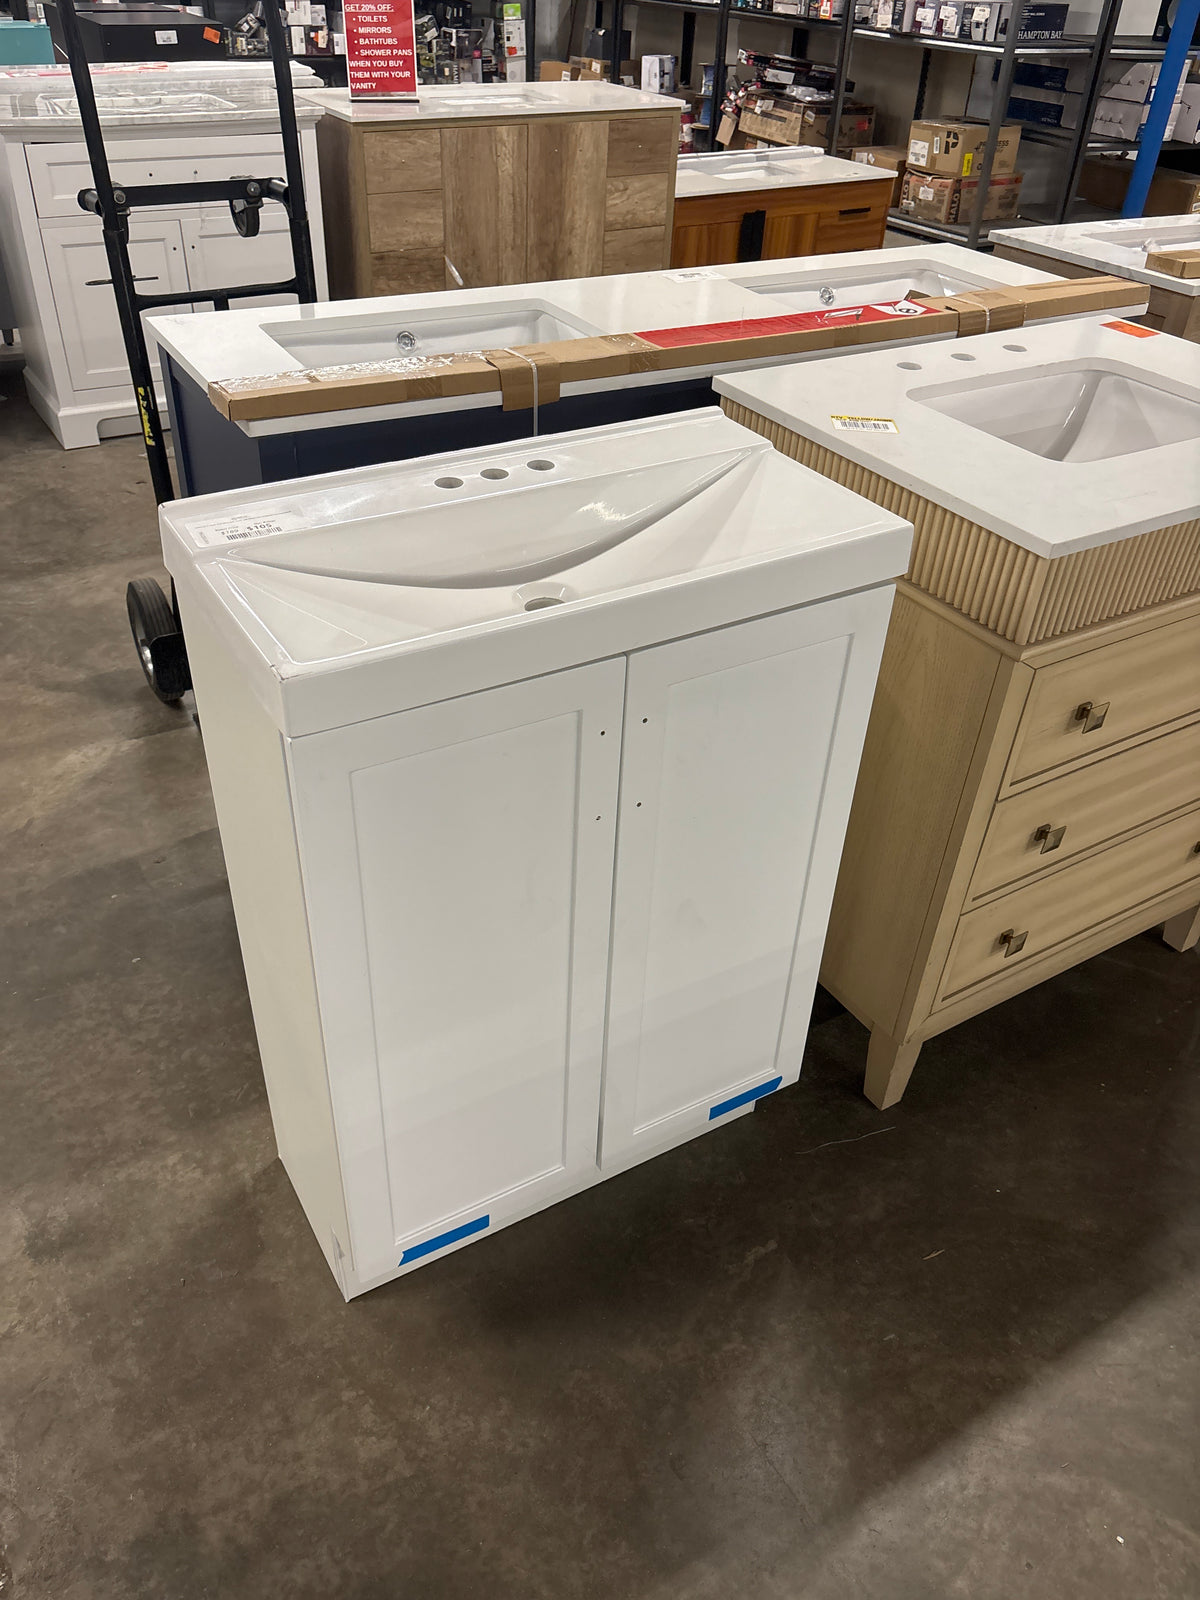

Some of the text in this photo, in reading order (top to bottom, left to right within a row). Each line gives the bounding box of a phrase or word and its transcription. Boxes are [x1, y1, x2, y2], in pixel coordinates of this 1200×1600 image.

[345, 4, 359, 12] GET
[361, 4, 376, 12] 20%
[1017, 30, 1064, 40] HAMPTON BAY
